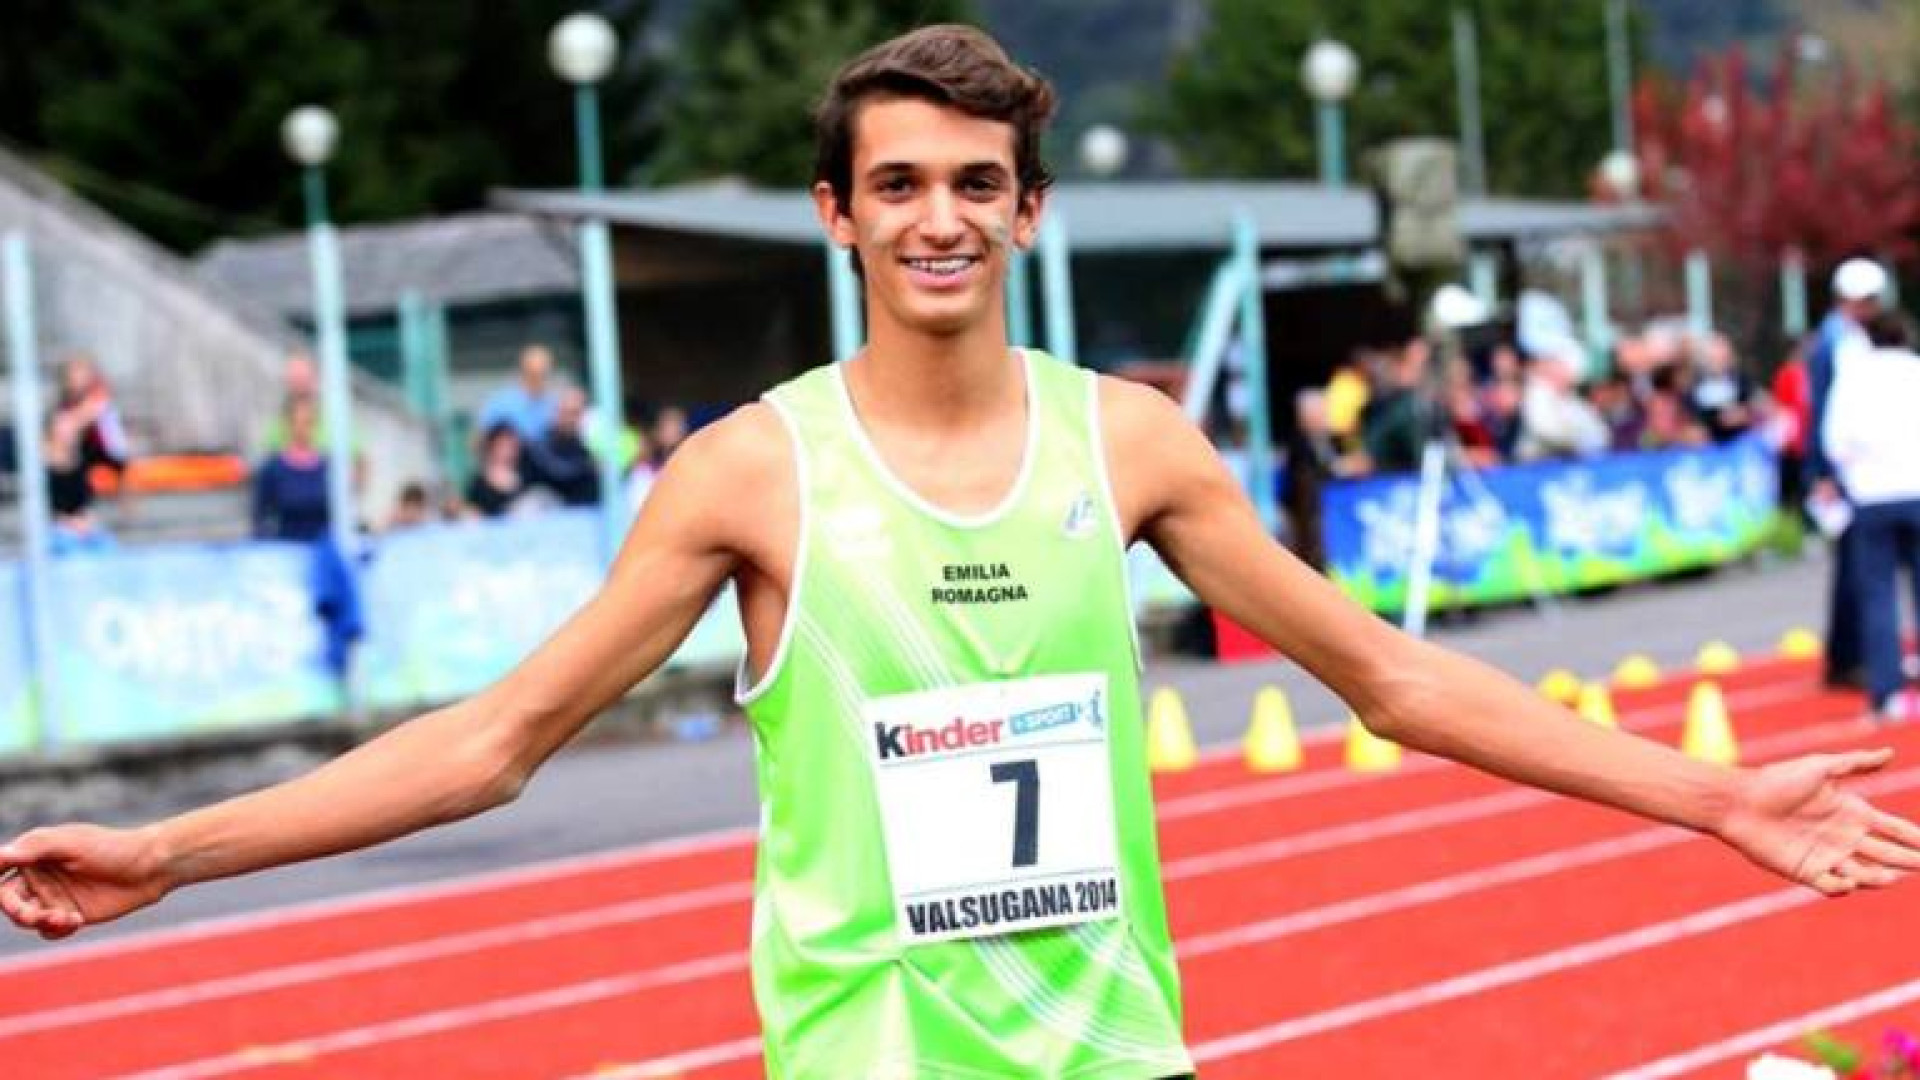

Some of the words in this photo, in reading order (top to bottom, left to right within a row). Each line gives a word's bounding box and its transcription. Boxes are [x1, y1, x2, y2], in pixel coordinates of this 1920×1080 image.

[942, 564, 1011, 581] EMILIA
[931, 585, 1029, 604] ROMAGNA
[990, 759, 1039, 867] 7
[906, 884, 1073, 934] VALSUGANA
[1074, 878, 1118, 913] 2014
